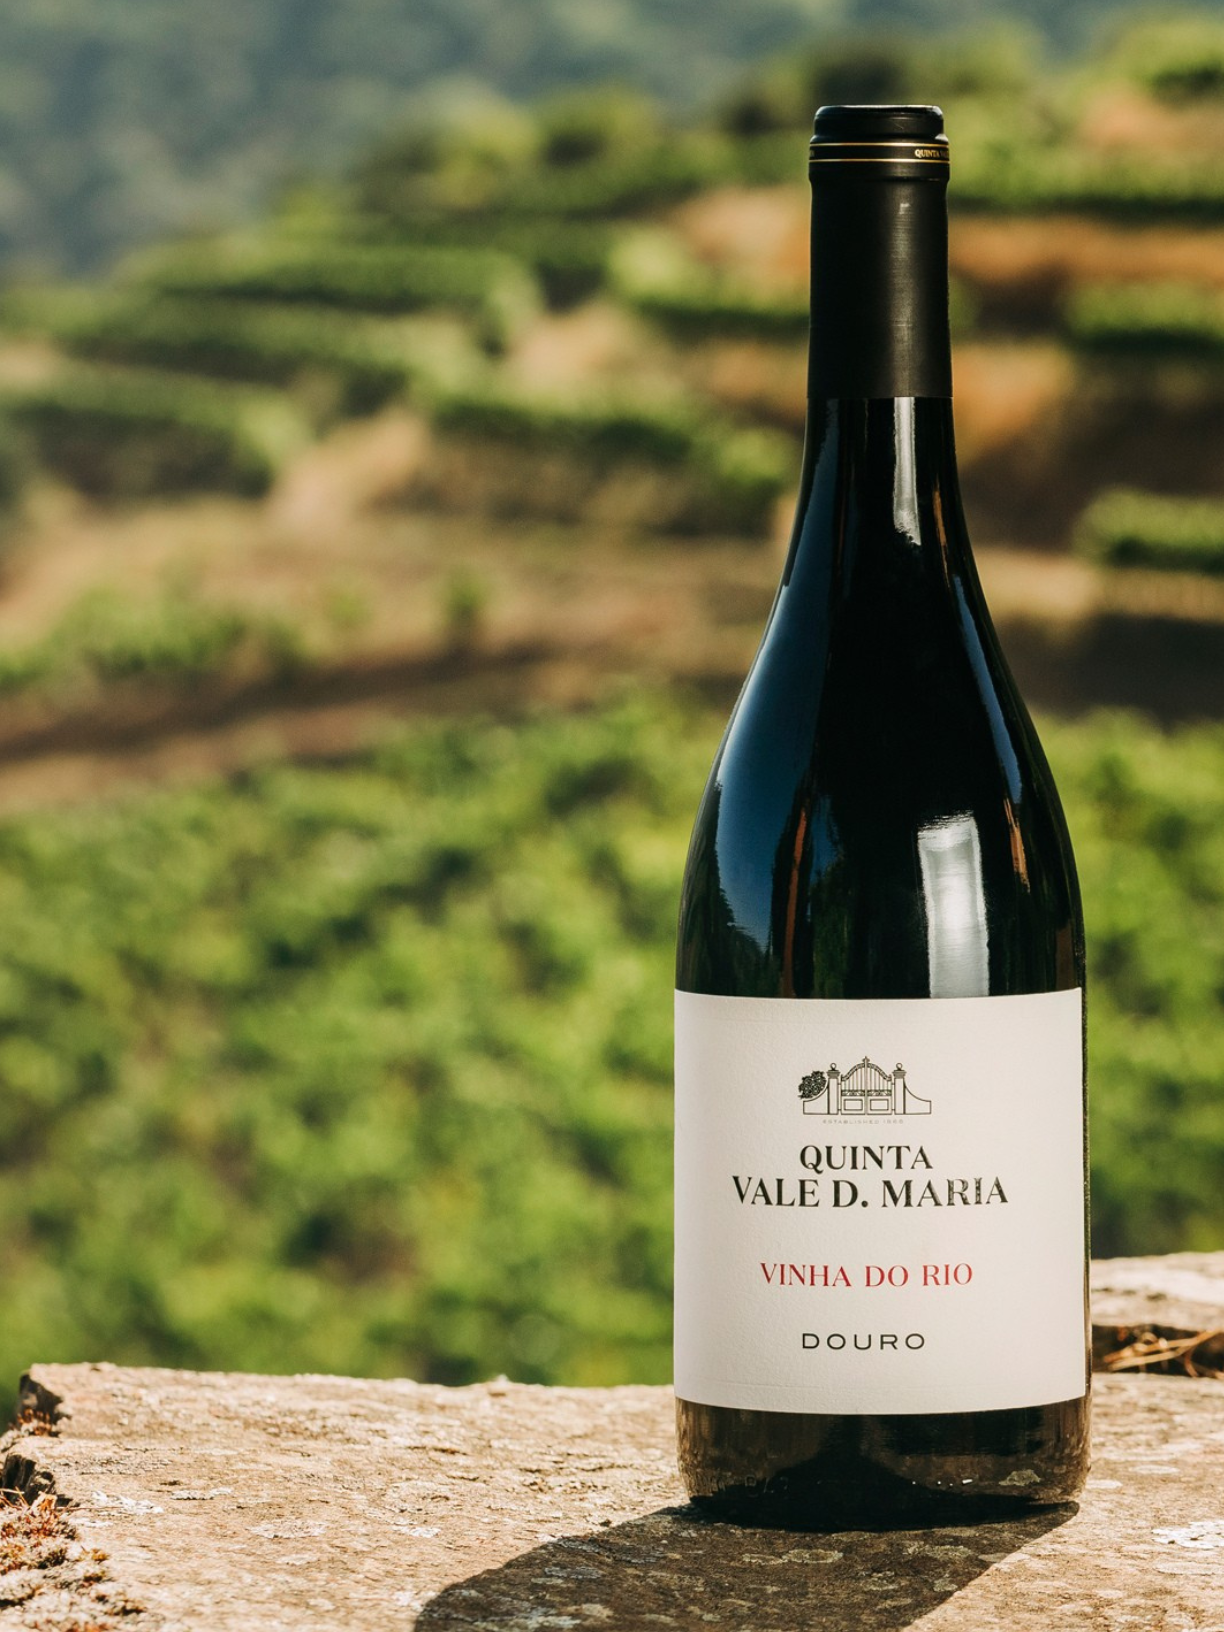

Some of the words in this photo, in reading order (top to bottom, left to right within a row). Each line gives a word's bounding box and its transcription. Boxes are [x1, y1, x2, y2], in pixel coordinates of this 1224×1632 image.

[914, 149, 940, 159] QUINTA
[799, 1144, 933, 1174] QUINTA
[731, 1175, 821, 1208] VALE
[832, 1178, 869, 1208] D.
[881, 1176, 1010, 1208] MARIA
[759, 1262, 852, 1287] VINHA
[865, 1265, 909, 1287] DO
[922, 1263, 973, 1286] RIO
[801, 1332, 925, 1351] DOURO
